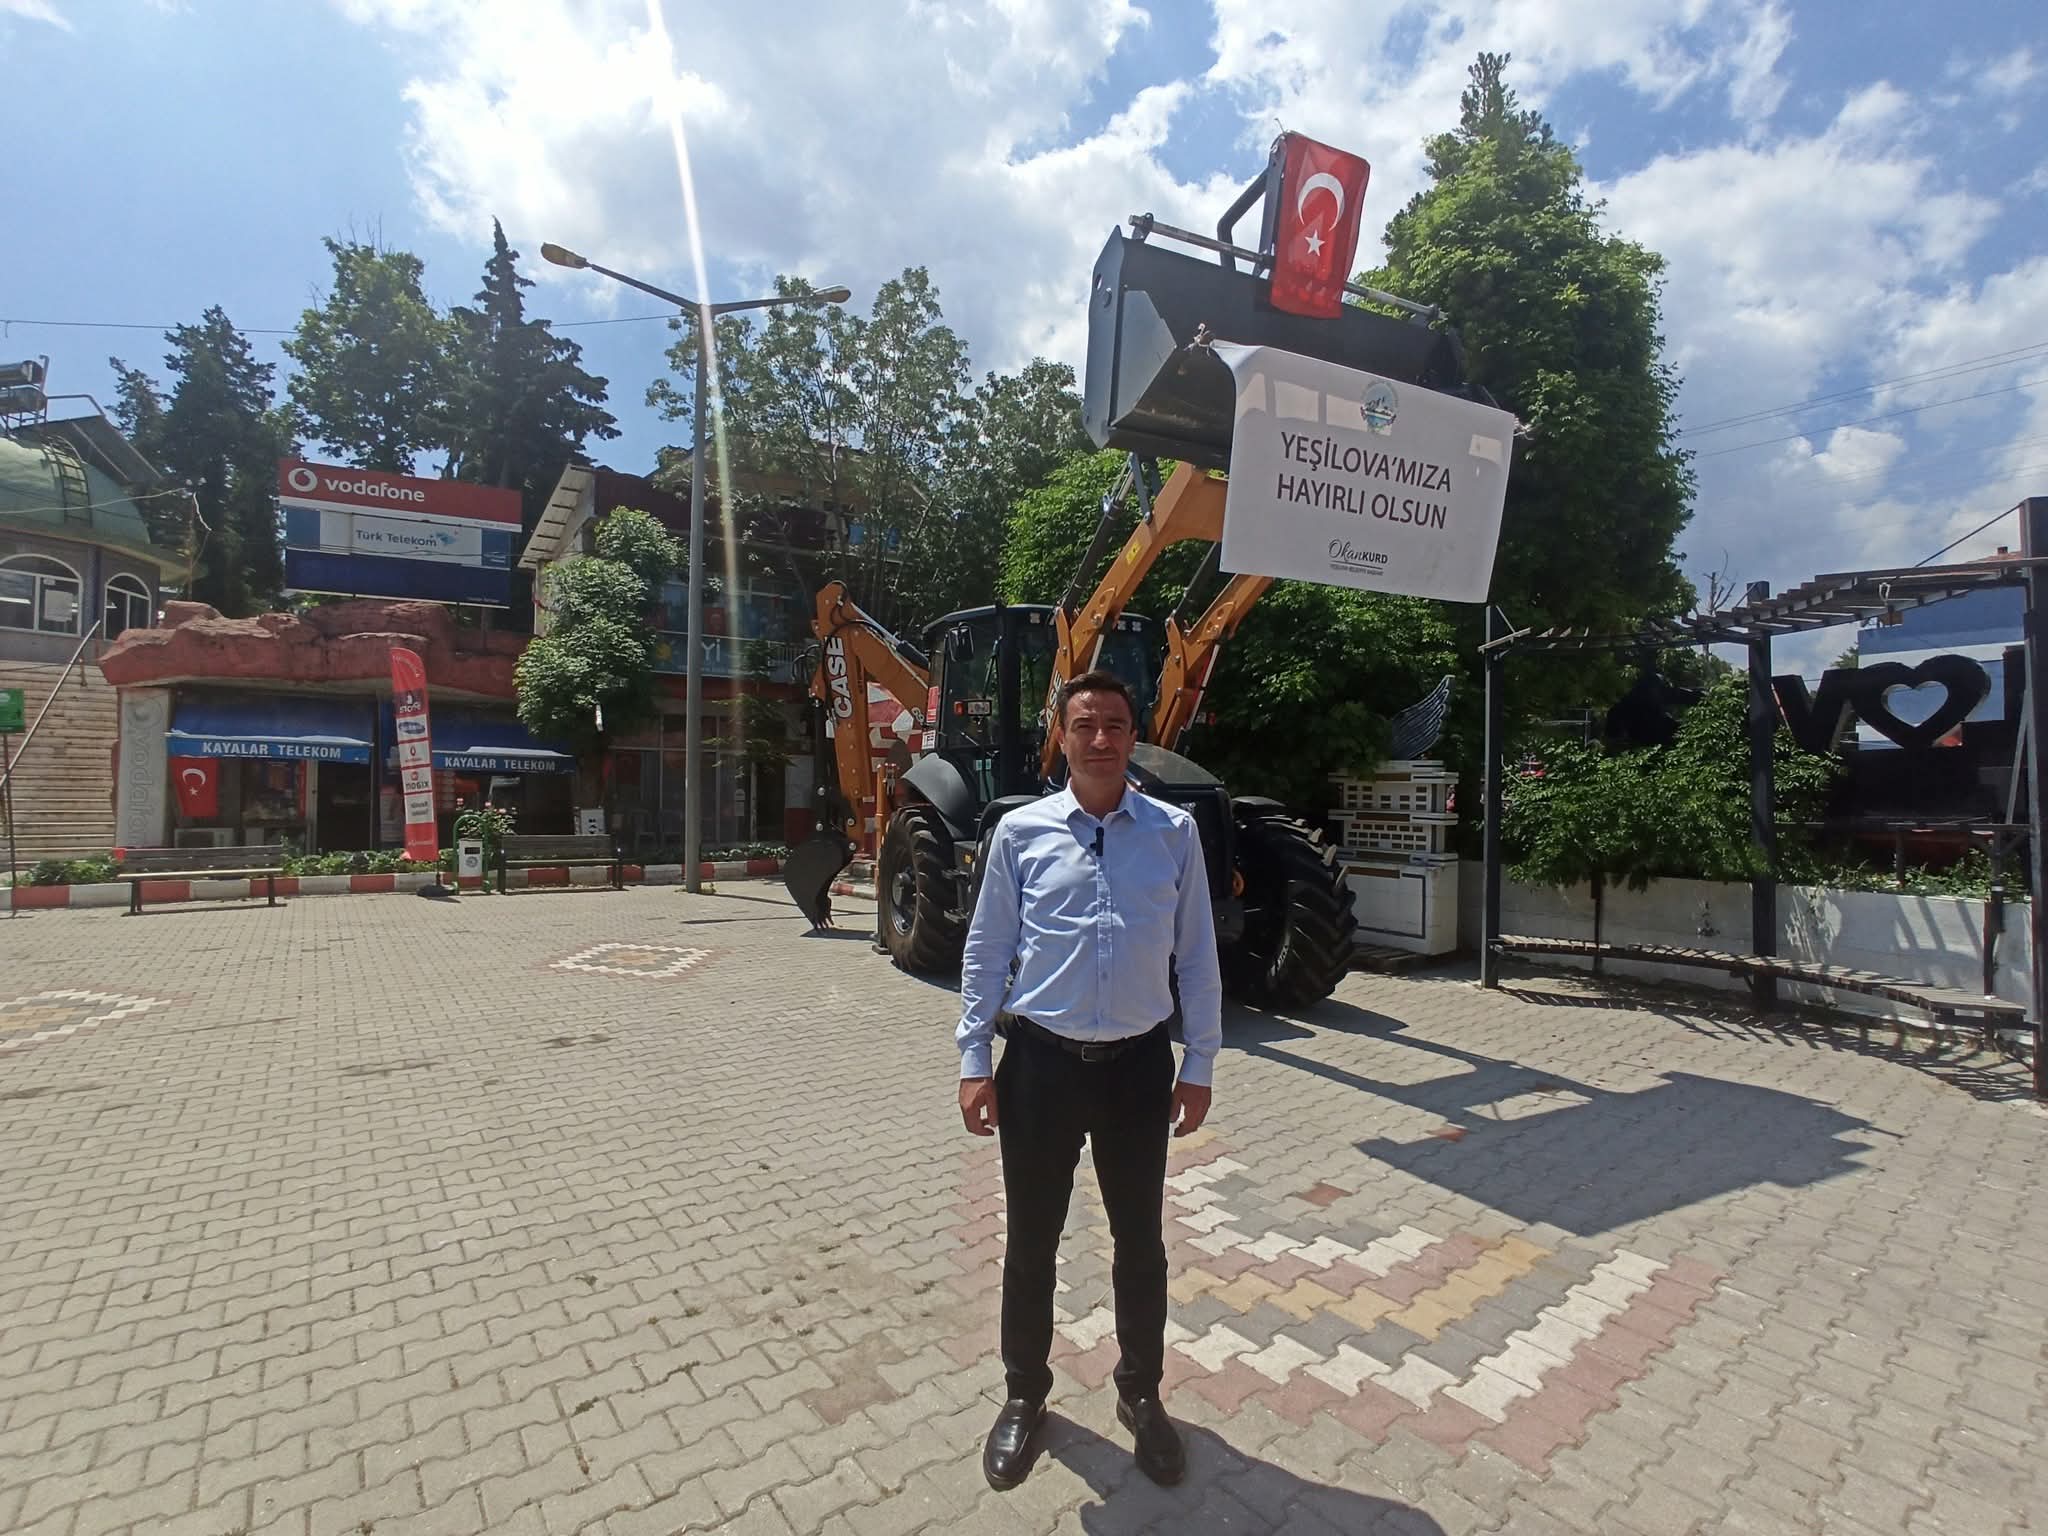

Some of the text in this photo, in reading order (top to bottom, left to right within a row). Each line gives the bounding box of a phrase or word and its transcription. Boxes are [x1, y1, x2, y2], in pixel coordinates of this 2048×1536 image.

[1281, 431, 1452, 493] YEŞİLOVA'MIZA
[325, 478, 425, 502] vodafone
[1277, 473, 1447, 529] HAYIRLI OLSUN
[356, 529, 437, 548] Türk Telekom
[826, 636, 853, 718] CASE
[202, 742, 341, 758] KAYALAR TELEKOM
[445, 757, 555, 771] KAYALAR TELEKOM
